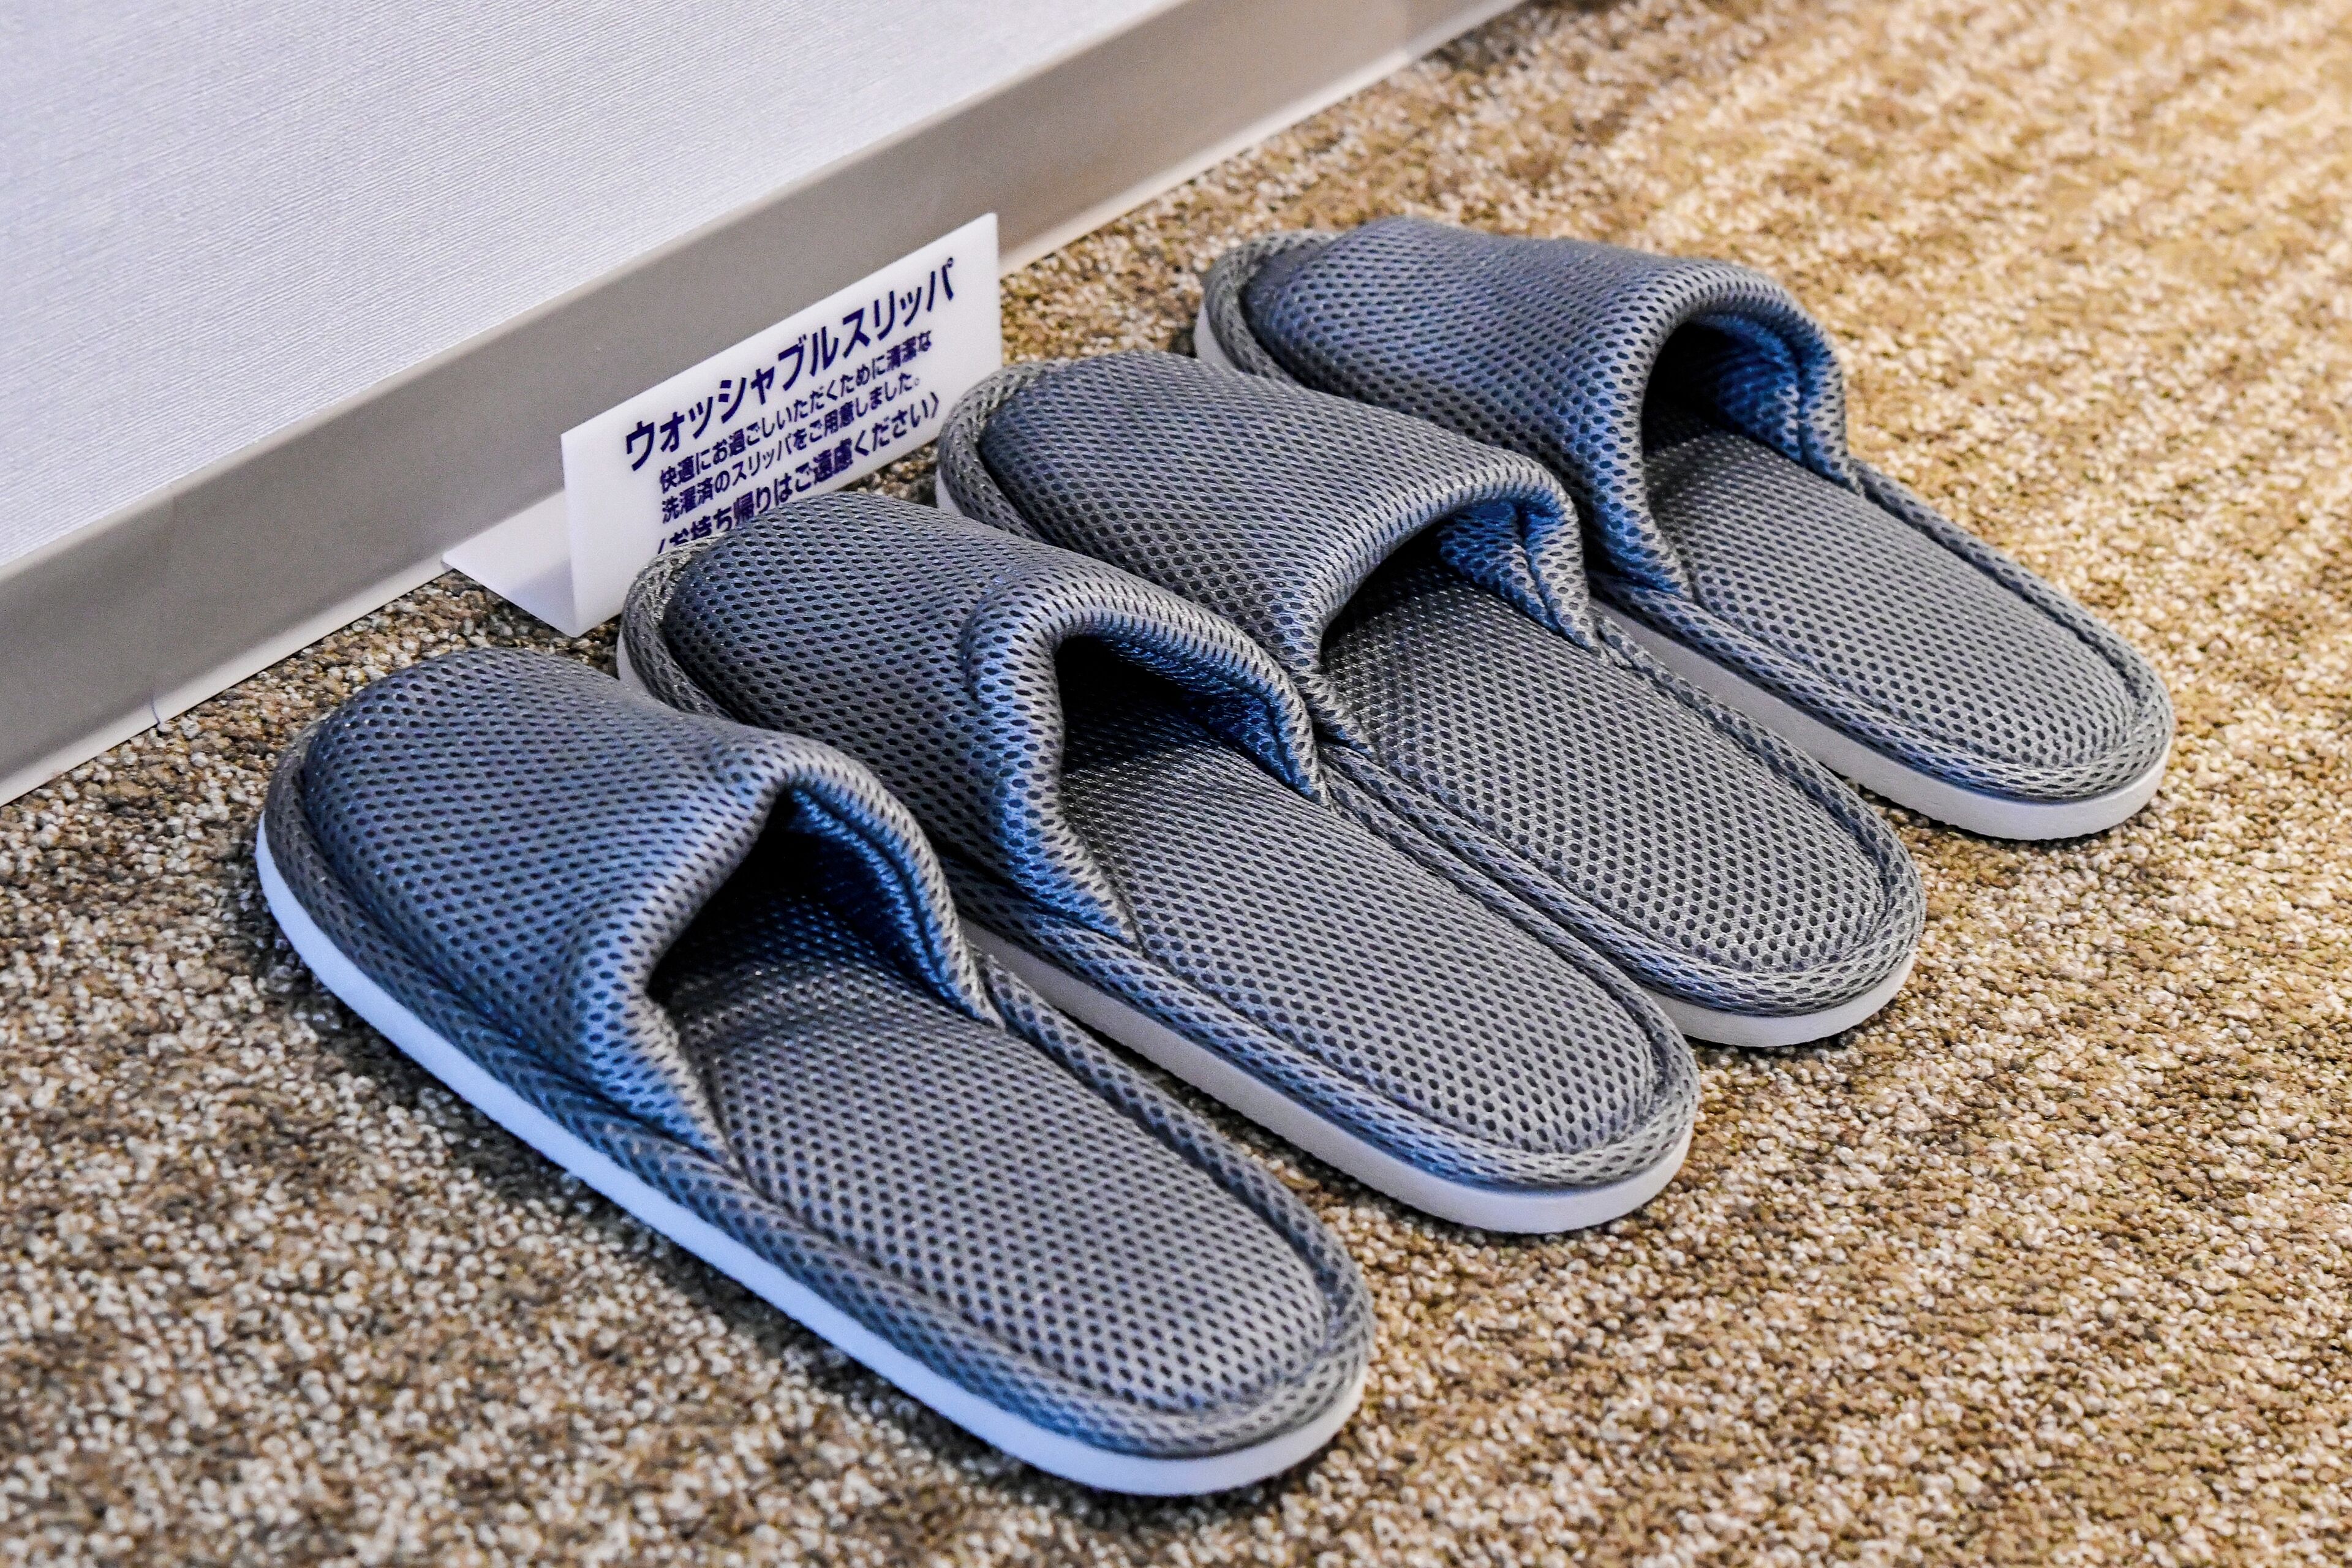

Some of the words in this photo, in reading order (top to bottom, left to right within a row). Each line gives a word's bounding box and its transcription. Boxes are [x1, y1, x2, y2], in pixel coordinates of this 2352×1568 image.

[625, 257, 954, 472] ウォッシャブルスリッパ
[659, 330, 932, 494] 快適にお過ごしいただくために清潔な
[662, 377, 920, 524] 洗濯済のスリッパをご用意しました。
